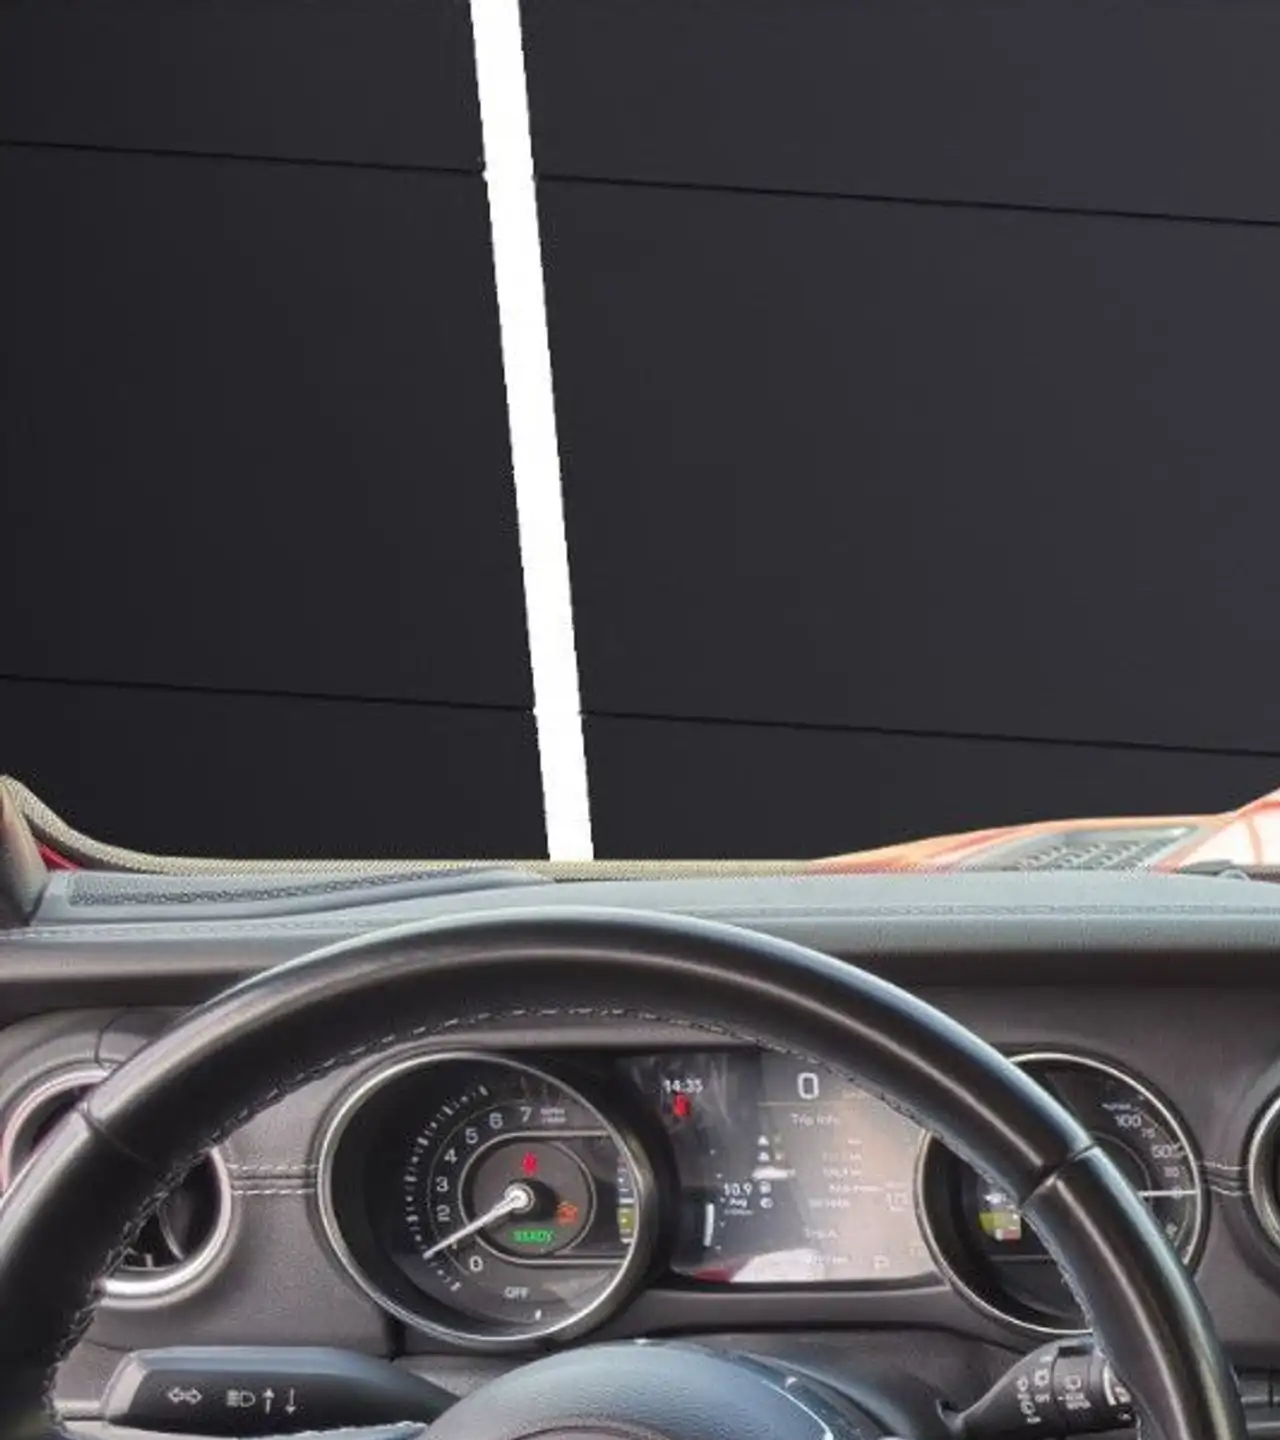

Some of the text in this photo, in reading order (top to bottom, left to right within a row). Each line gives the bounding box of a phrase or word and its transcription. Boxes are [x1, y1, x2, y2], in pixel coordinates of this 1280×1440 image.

[663, 1078, 703, 1093] 14:35
[797, 1072, 819, 1099] 0
[488, 1112, 504, 1129] 6
[519, 1106, 532, 1123] 7
[1114, 1114, 1142, 1129] 100
[465, 1128, 478, 1144] 5
[444, 1147, 458, 1164] 4
[436, 1176, 449, 1192] 3
[469, 1255, 483, 1273] 0
[504, 1286, 530, 1298] OFF
